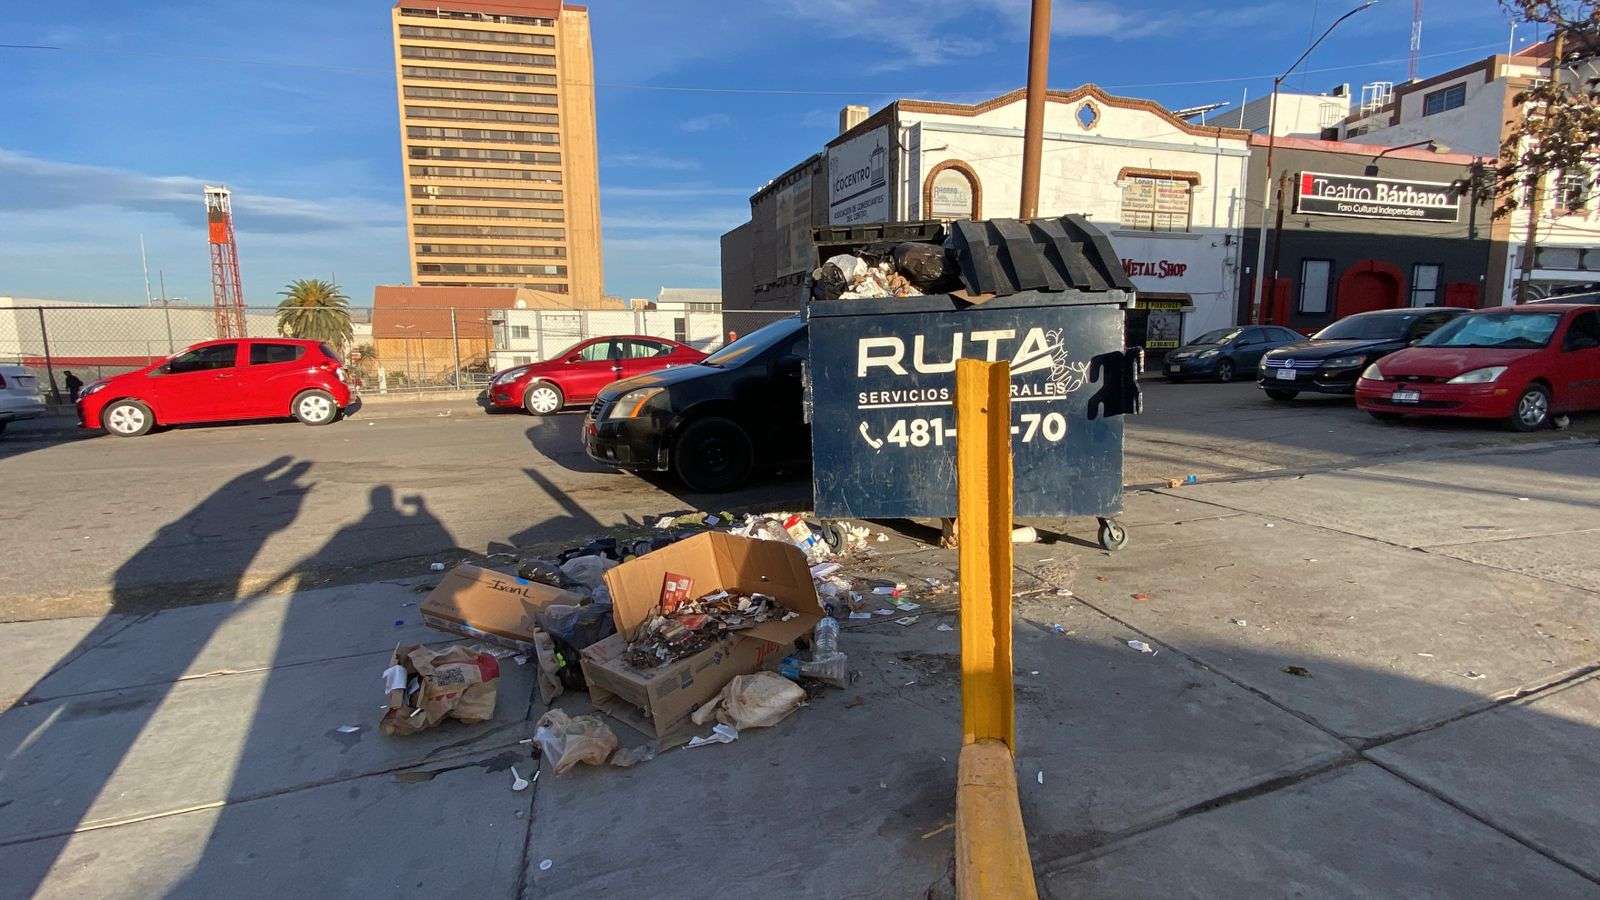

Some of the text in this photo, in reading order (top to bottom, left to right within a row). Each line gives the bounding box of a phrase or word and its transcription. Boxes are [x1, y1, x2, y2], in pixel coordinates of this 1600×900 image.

[1313, 178, 1447, 206] Teatro Bárbaro
[1337, 203, 1424, 216] Foro Cultural Independiente
[1121, 258, 1187, 279] METAL SHOP
[857, 327, 1058, 378] RUTA
[858, 382, 1067, 405] SERVICIOS RALES
